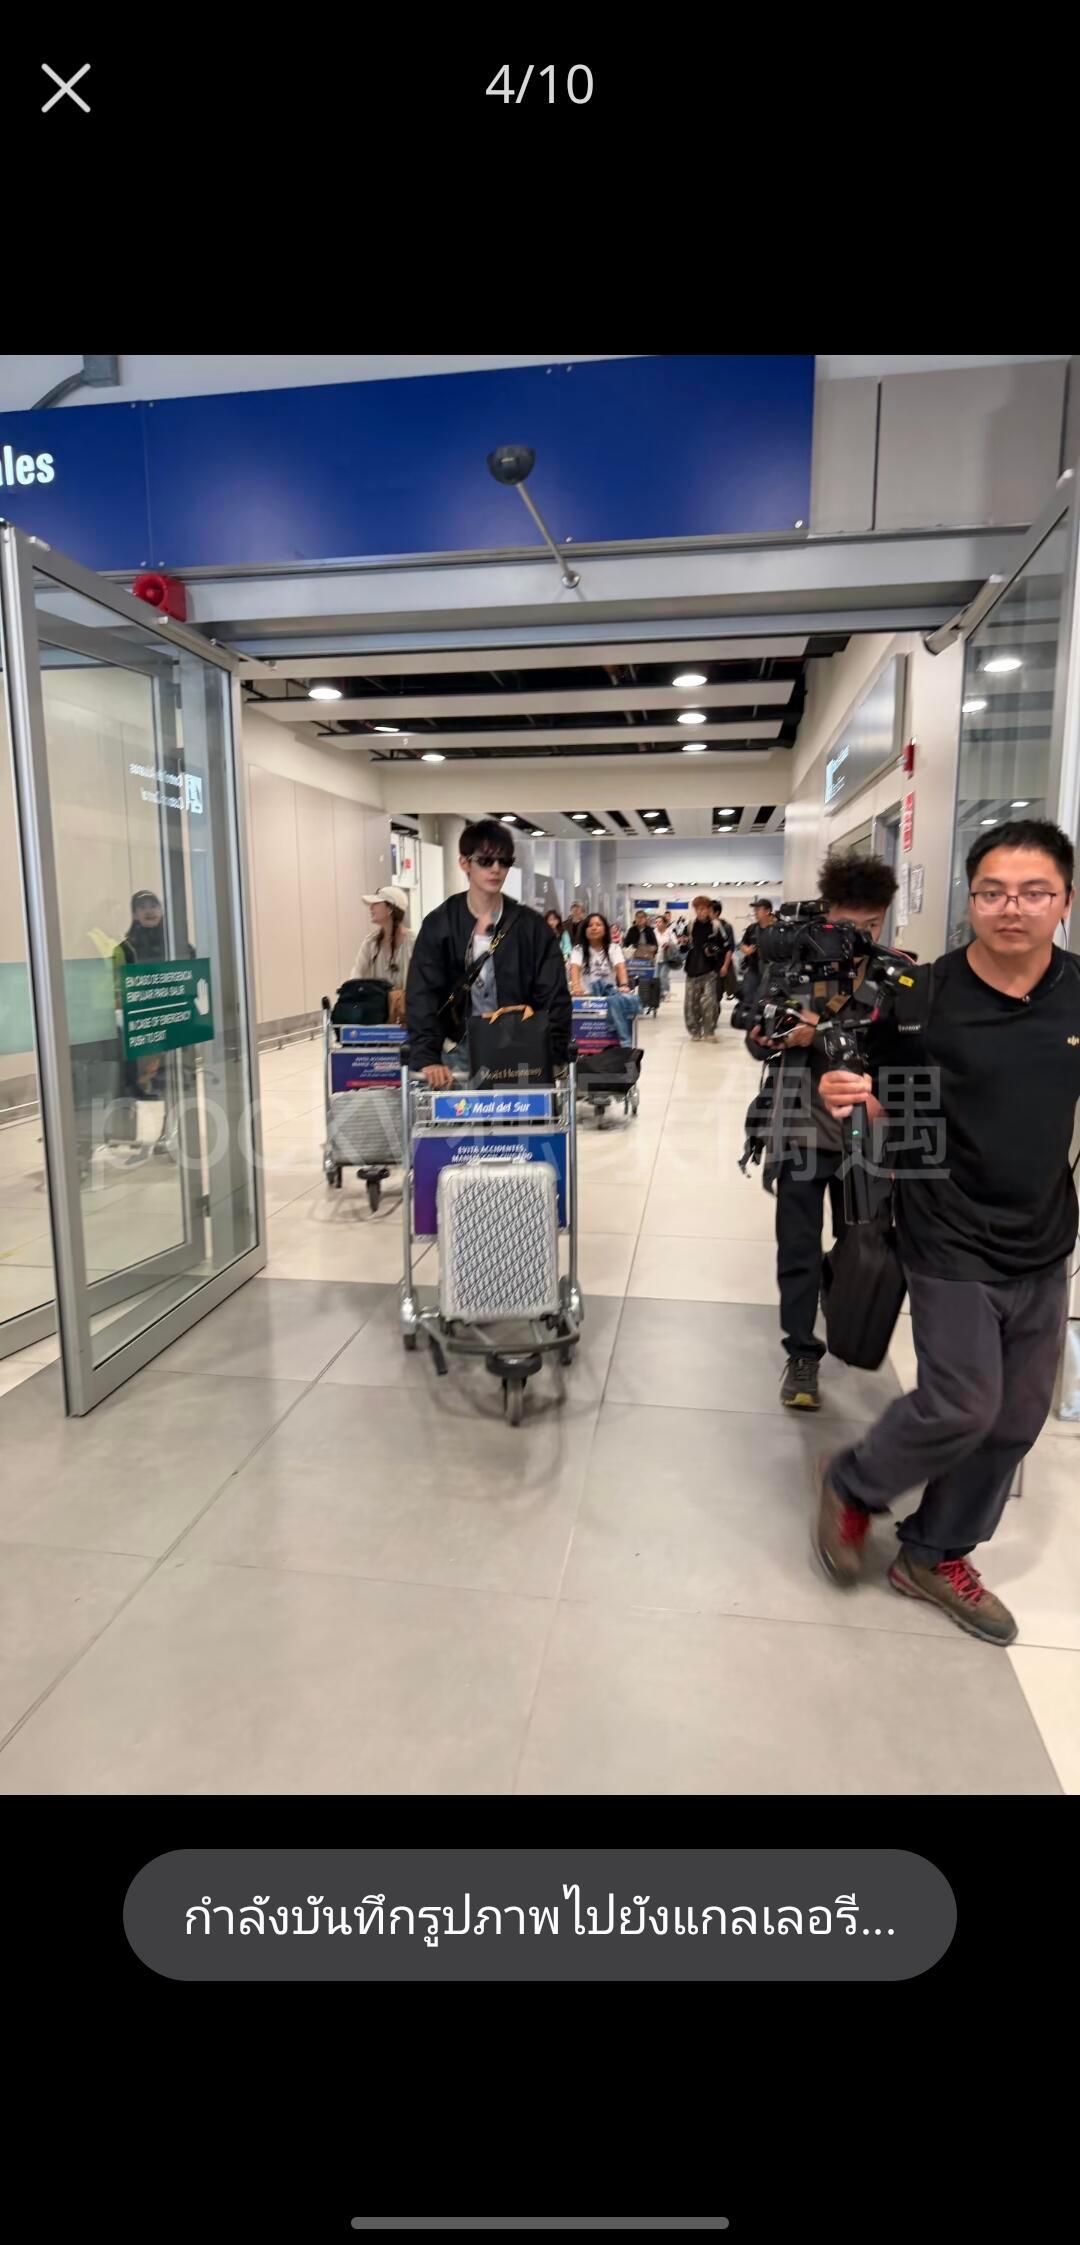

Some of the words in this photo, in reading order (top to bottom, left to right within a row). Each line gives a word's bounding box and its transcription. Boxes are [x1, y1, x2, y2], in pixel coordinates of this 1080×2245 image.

[0, 445, 55, 487] les
[472, 1101, 496, 1114] Mall
[496, 1101, 511, 1113] del
[512, 1101, 531, 1113] Sur
